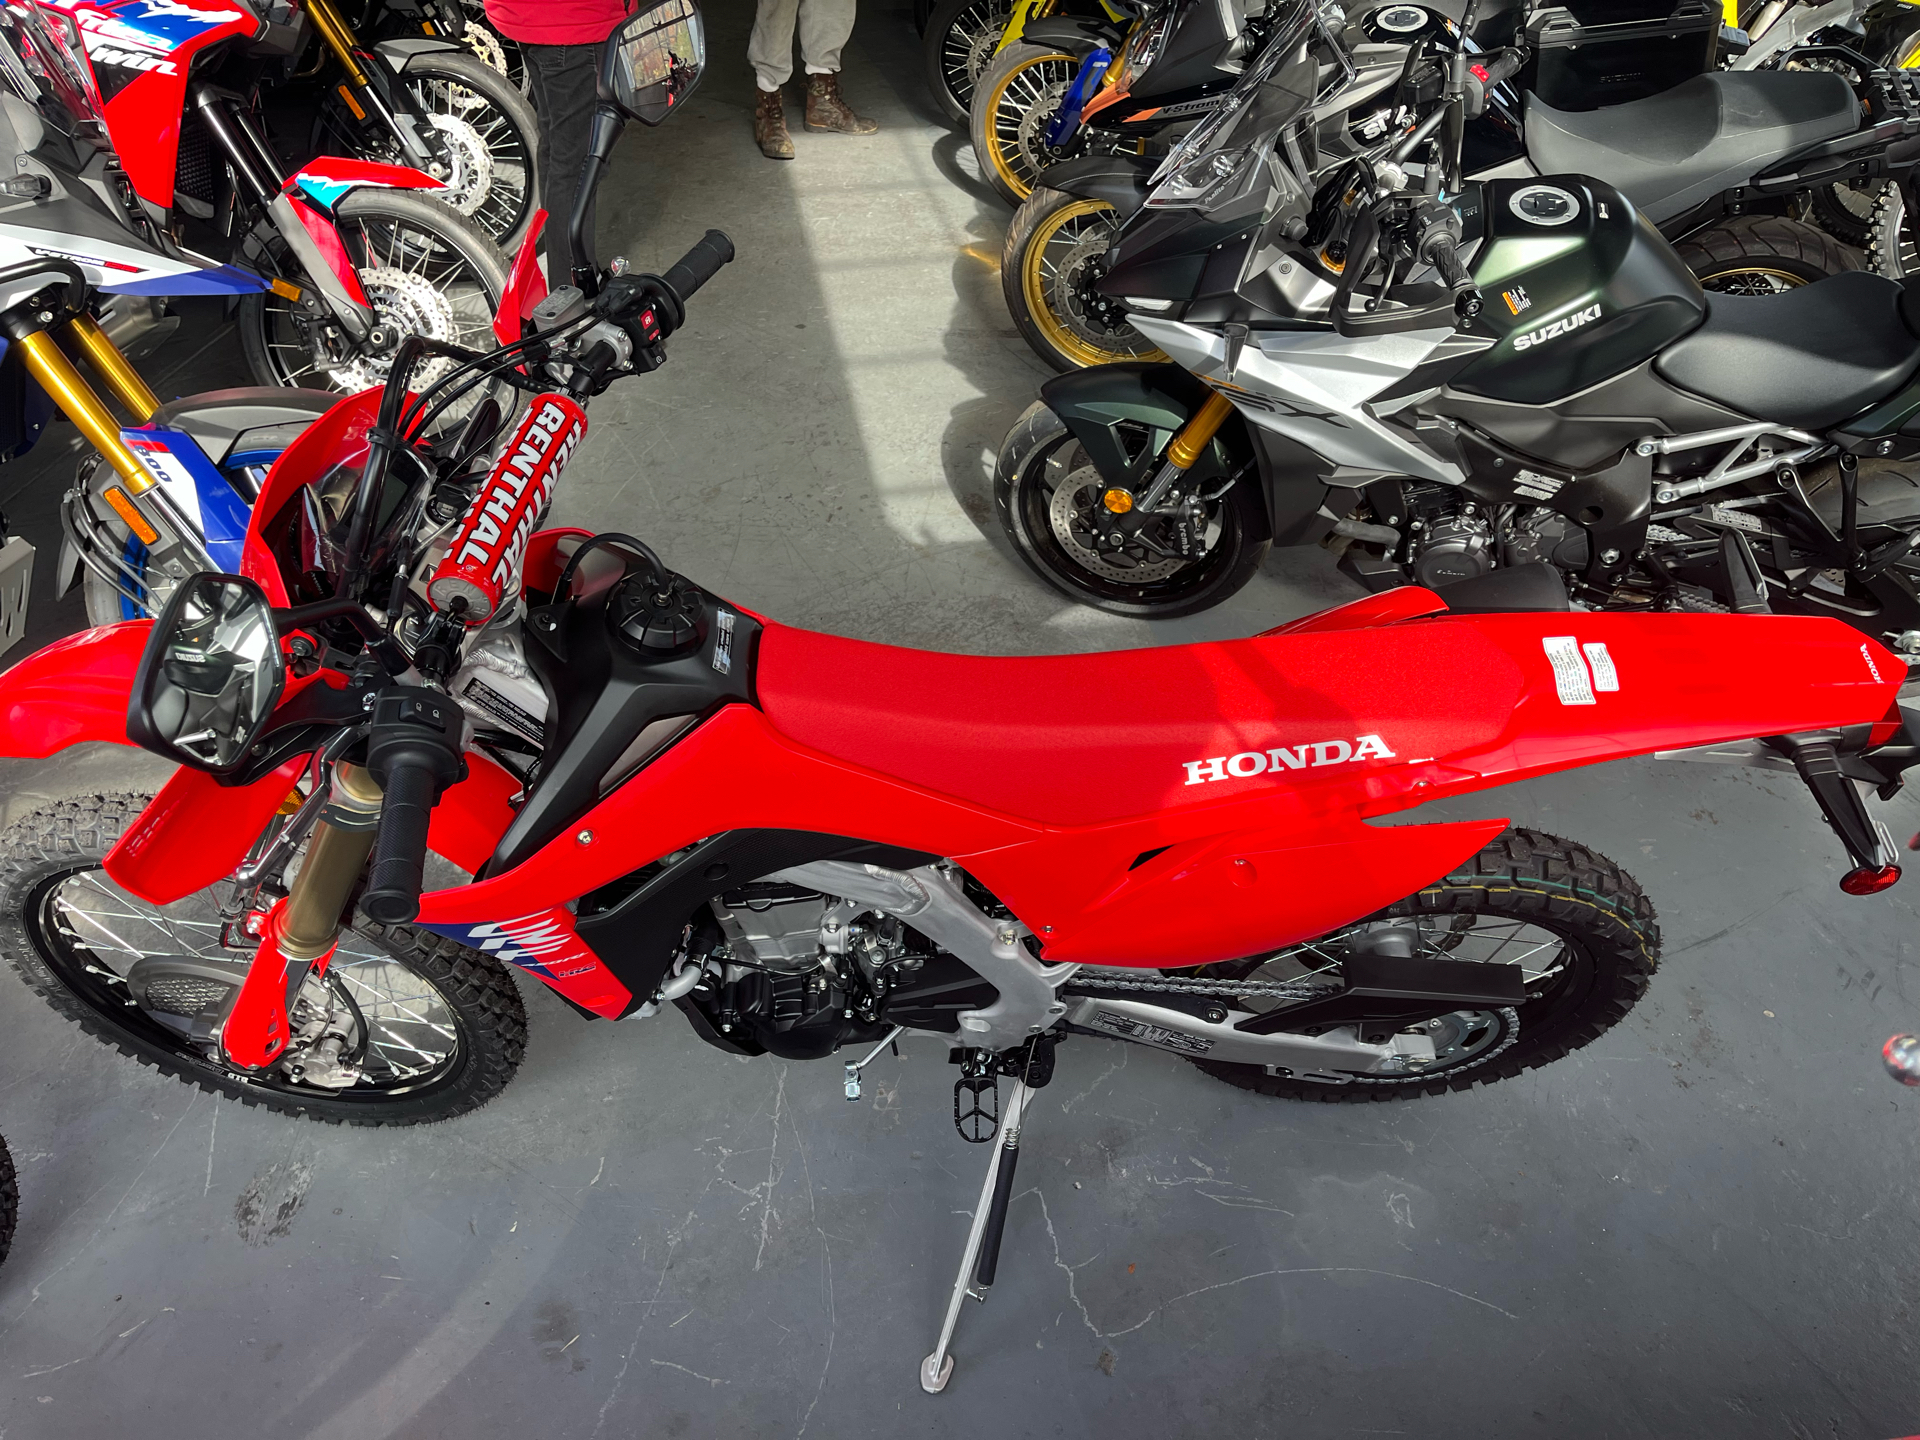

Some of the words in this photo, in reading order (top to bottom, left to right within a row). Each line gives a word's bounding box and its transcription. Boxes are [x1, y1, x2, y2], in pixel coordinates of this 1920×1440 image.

[1513, 304, 1602, 351] SUZUKI
[133, 445, 173, 482] 800
[456, 402, 567, 565] RENTHAL
[1178, 522, 1191, 555] brembo
[1860, 643, 1885, 684] HONDA
[1182, 734, 1396, 786] HONDA
